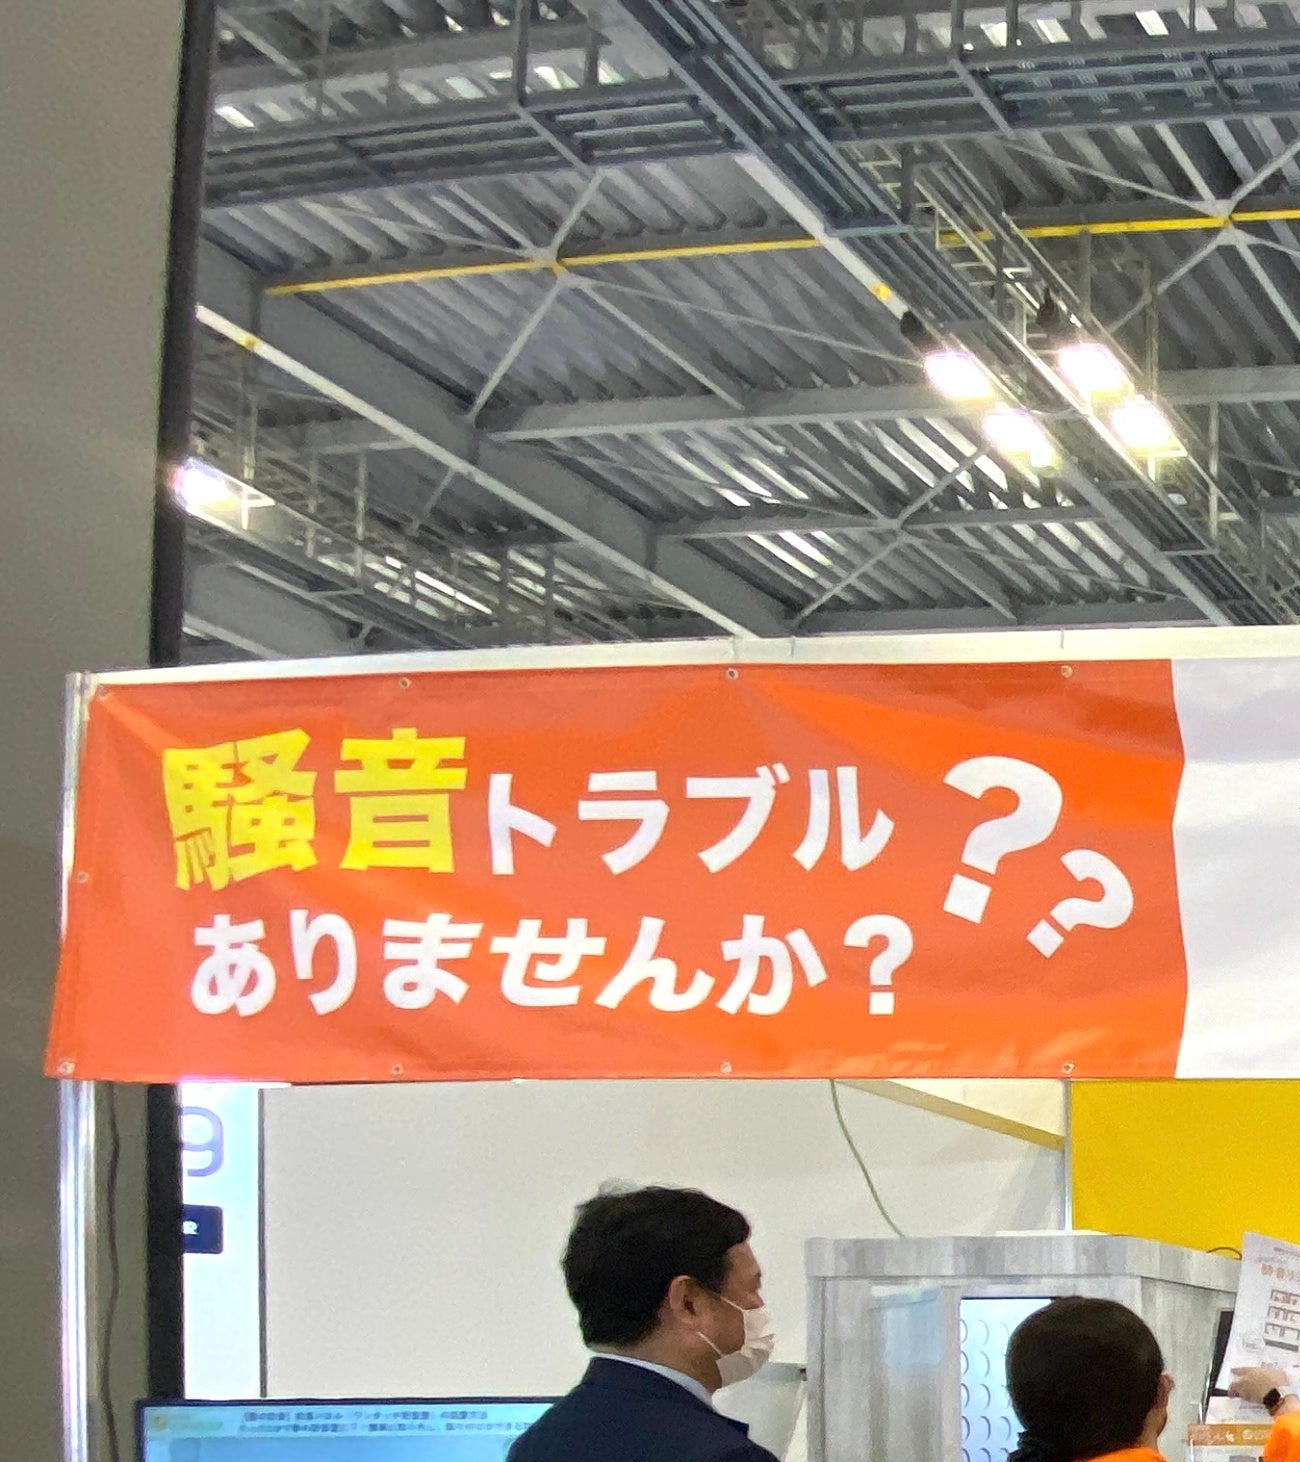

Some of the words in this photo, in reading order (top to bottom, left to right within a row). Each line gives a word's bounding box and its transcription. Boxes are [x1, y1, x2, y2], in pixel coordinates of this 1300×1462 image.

[162, 727, 896, 890] 騒音トラブル
[942, 756, 1063, 924] ?
